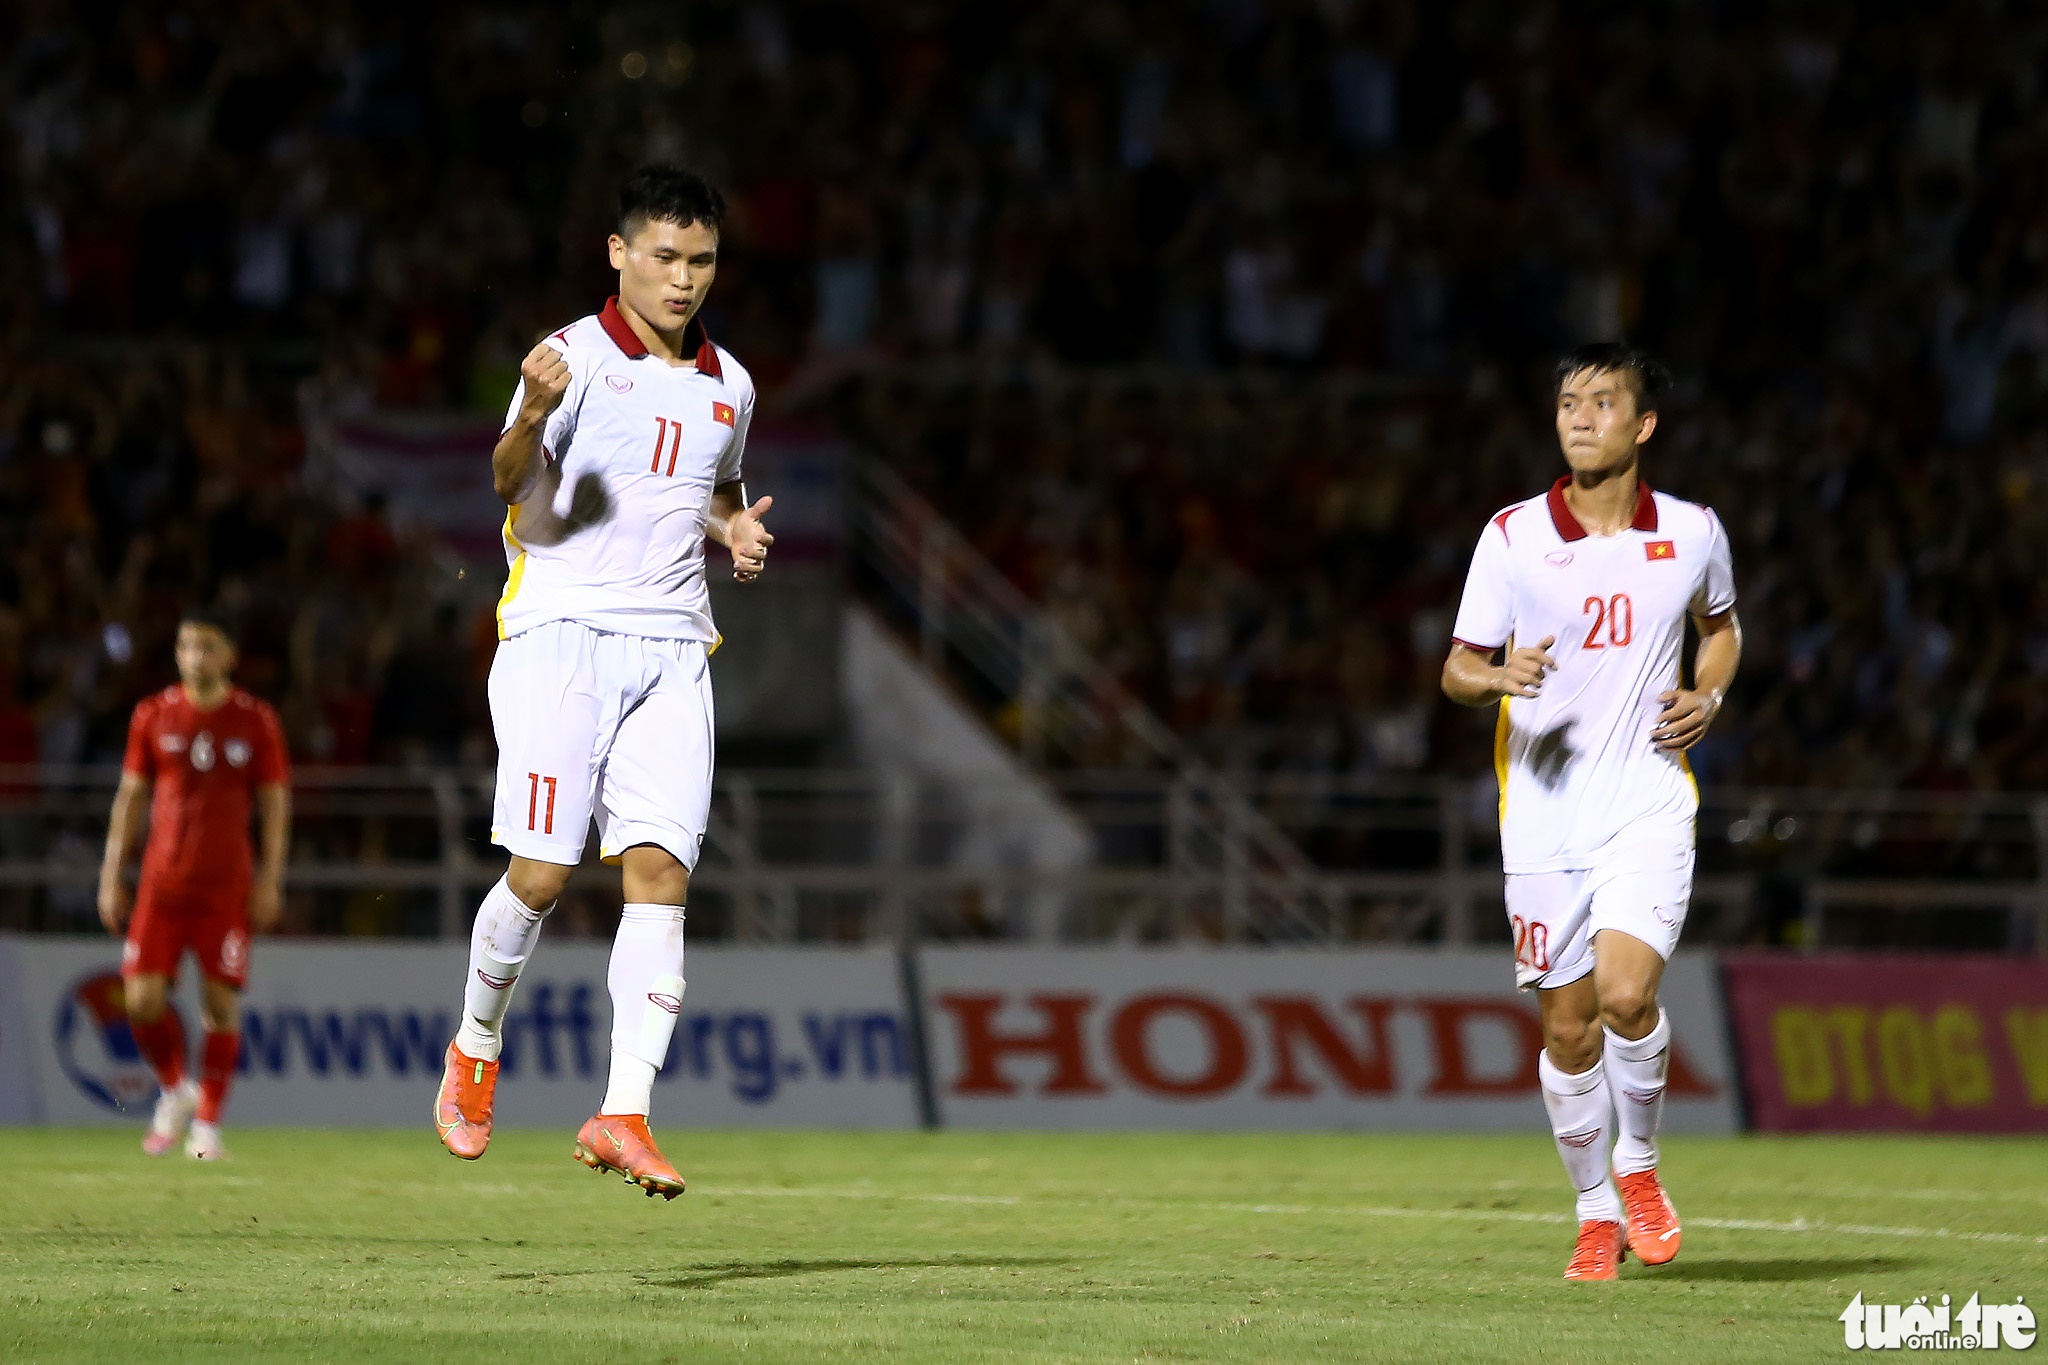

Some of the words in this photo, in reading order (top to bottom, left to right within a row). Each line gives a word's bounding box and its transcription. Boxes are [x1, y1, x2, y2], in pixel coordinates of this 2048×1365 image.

[651, 416, 682, 477] 11
[1582, 593, 1632, 649] 20
[189, 730, 216, 772] 6
[527, 772, 558, 834] 11
[1511, 914, 1549, 972] 20
